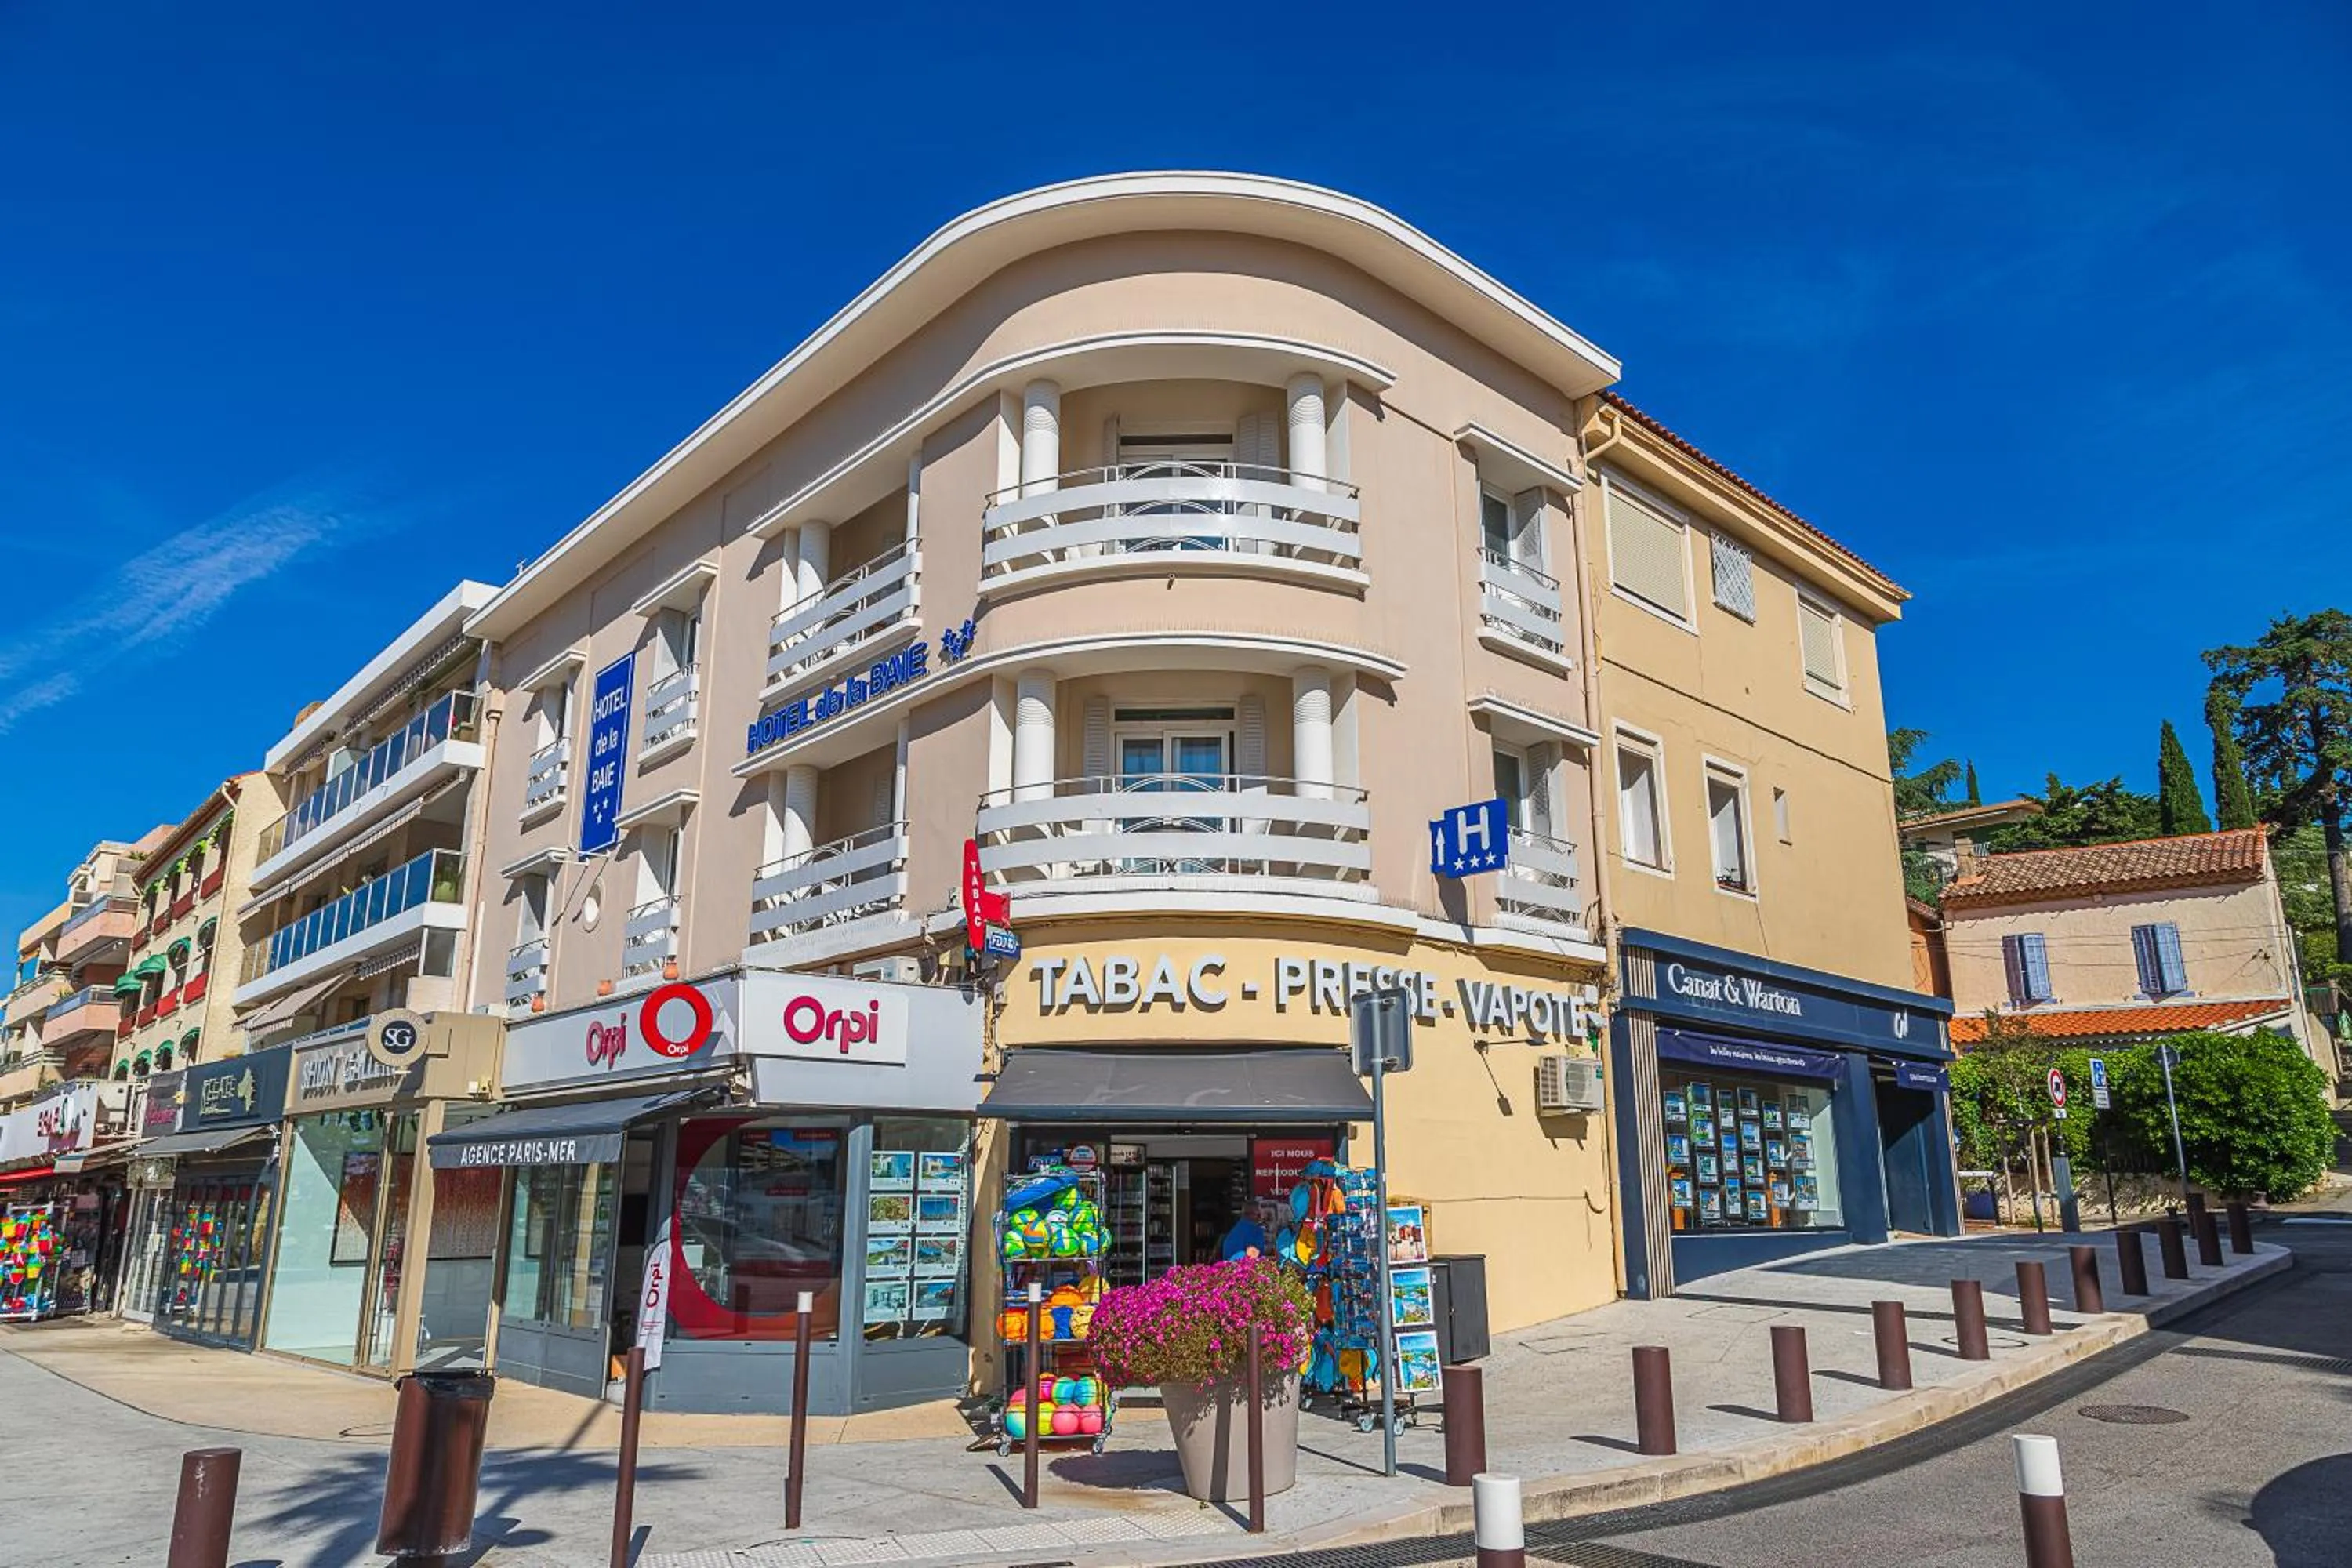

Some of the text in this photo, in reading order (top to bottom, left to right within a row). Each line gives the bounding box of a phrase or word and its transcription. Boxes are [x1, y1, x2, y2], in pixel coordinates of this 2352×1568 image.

[593, 686, 626, 723] HOTEL
[747, 642, 928, 753] HOTEL de la BAIE
[595, 727, 619, 757] de la
[591, 762, 615, 794] BAIE
[1457, 806, 1490, 855] H
[970, 861, 982, 927] TABAC
[1032, 953, 1229, 1006] TABAC
[1462, 980, 1589, 1038] VAPOTE
[1668, 963, 1802, 1017] Canat & Warton
[384, 1028, 412, 1047] SG
[586, 1012, 627, 1069] Orpi
[784, 996, 879, 1054] Orpi
[667, 1044, 690, 1055] Orpi
[460, 1140, 577, 1165] AGENCE PARIS-MER
[1270, 1149, 1315, 1158] ICI NOUS
[646, 1262, 663, 1308] Orpi
